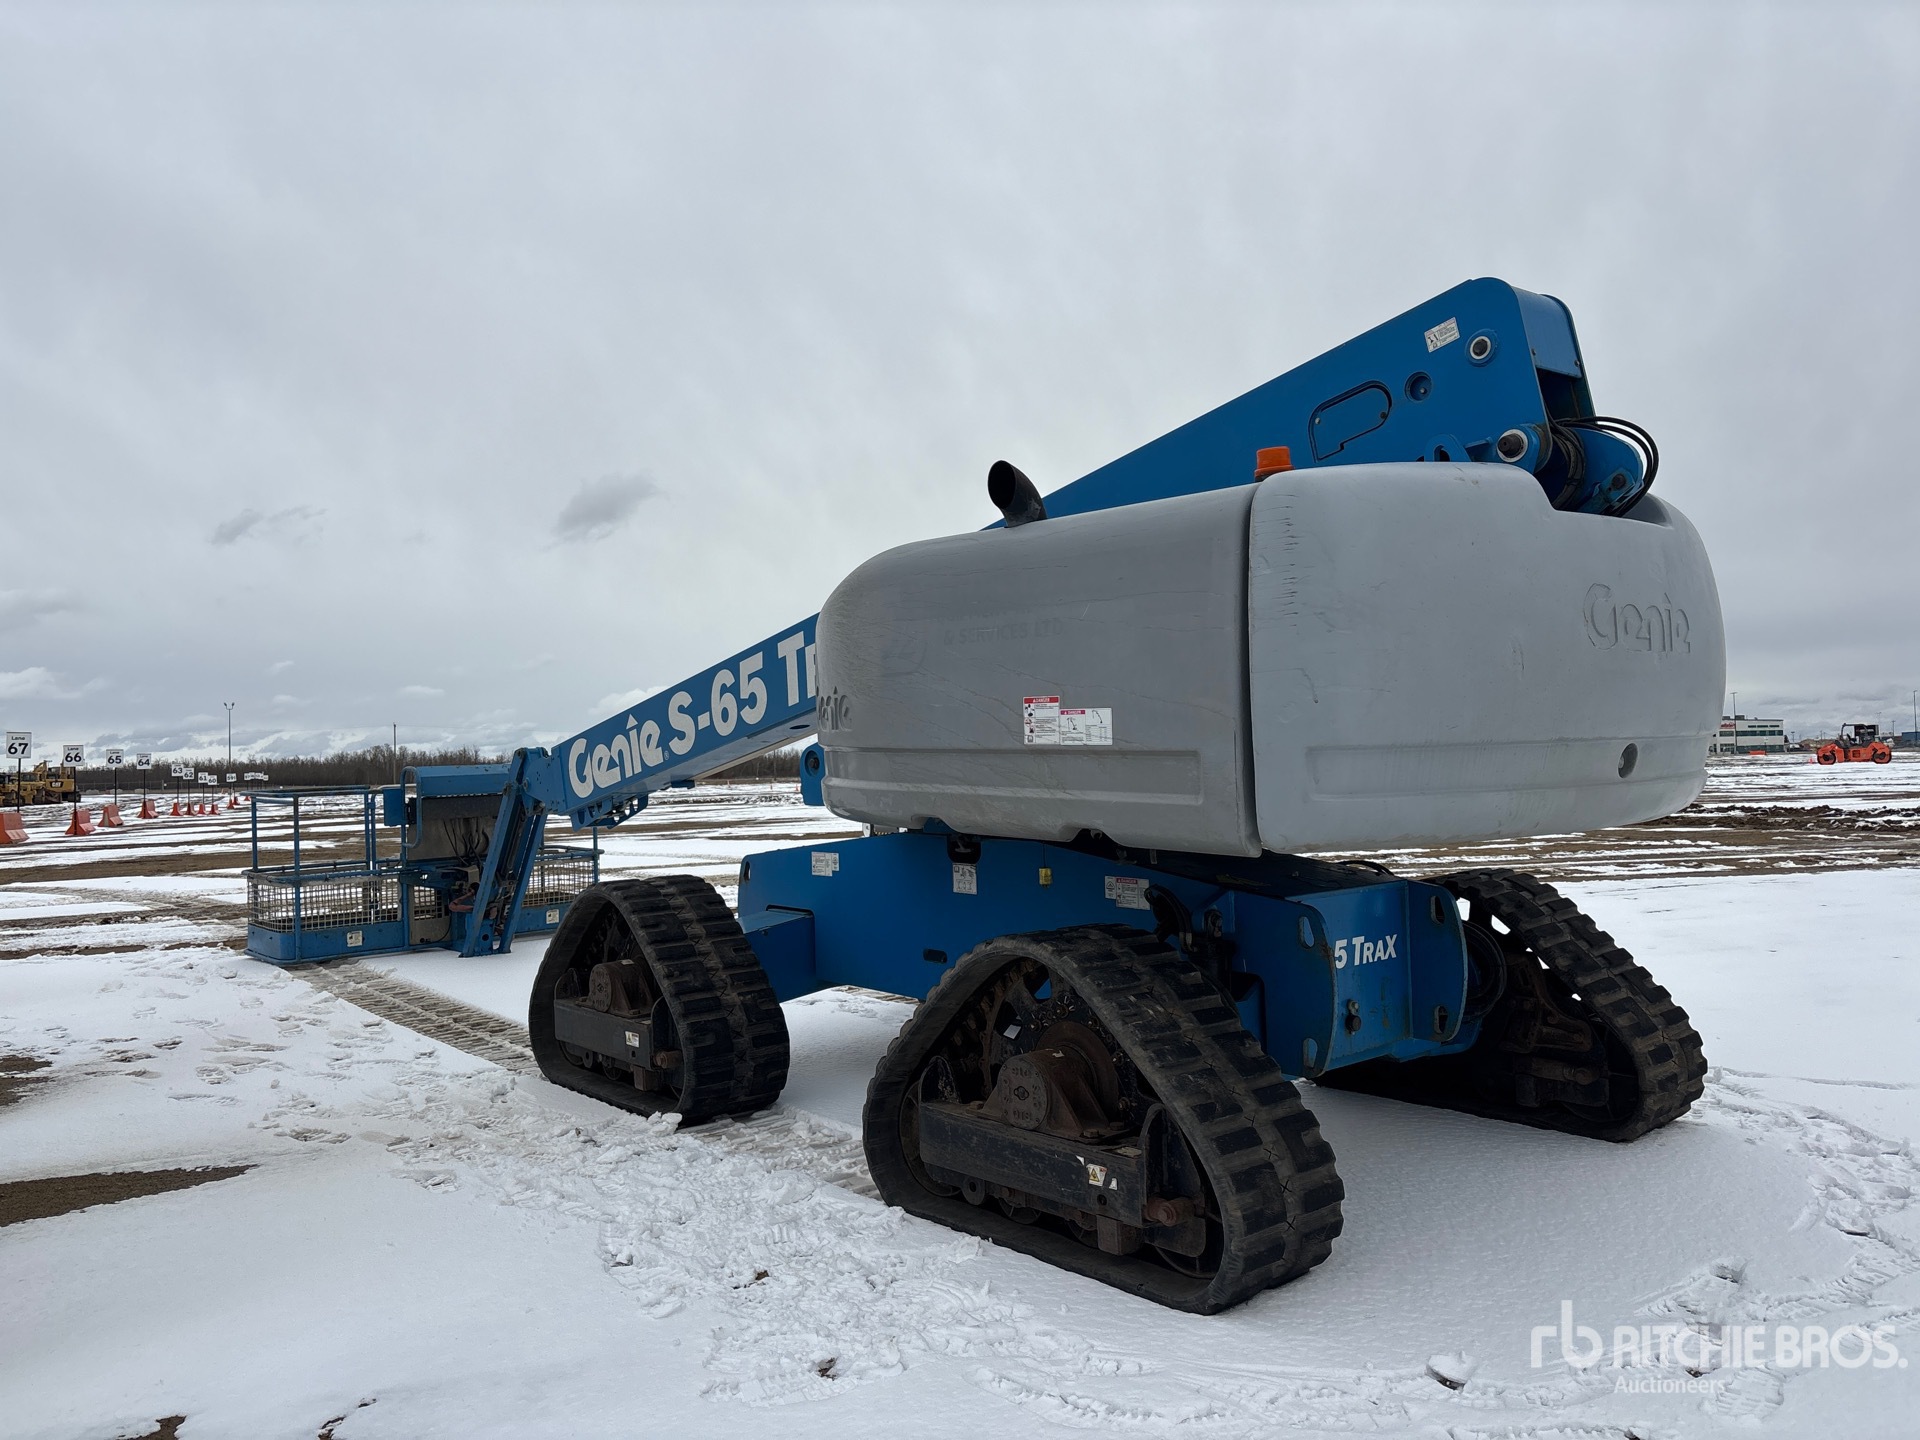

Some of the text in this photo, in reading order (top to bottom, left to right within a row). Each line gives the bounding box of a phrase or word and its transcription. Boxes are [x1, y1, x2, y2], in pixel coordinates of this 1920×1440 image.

[1583, 583, 1690, 653] Genie
[568, 714, 664, 798] Genie
[668, 651, 767, 755] S-65
[8, 743, 29, 754] 67
[65, 752, 82, 762] 66
[107, 755, 122, 764] 65
